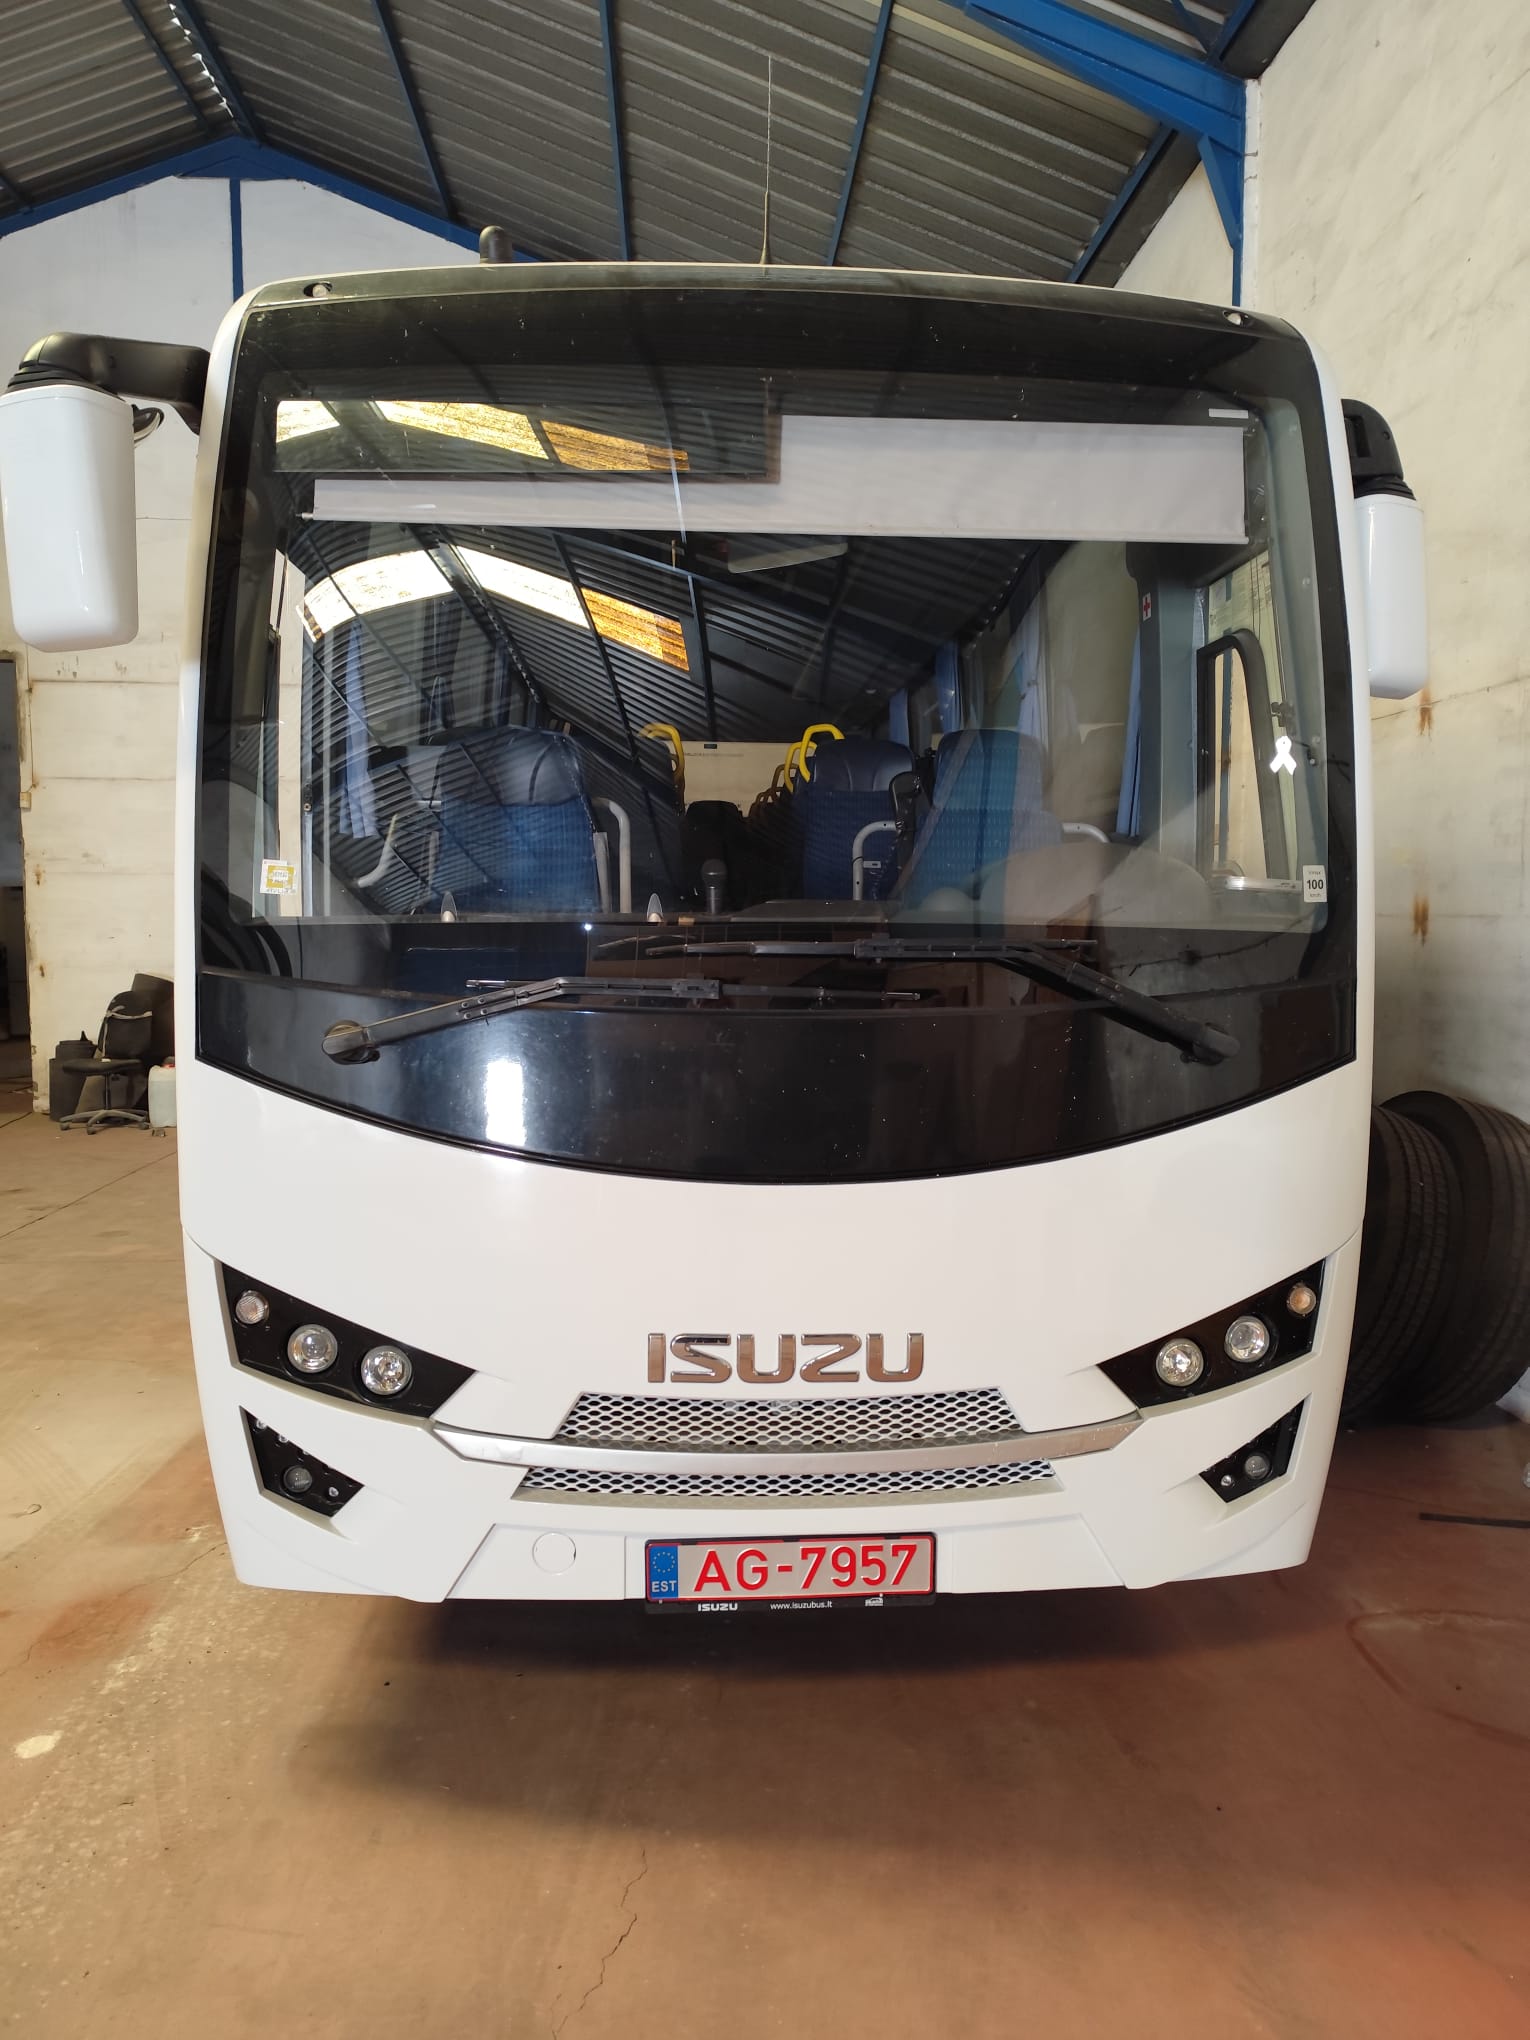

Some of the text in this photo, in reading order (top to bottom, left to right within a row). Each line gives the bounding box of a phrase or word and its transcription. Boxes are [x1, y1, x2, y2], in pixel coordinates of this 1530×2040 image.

[1306, 879, 1324, 890] 100
[647, 1333, 924, 1383] ISUZU
[693, 1543, 918, 1592] AG-7957
[651, 1580, 677, 1593] EST
[697, 1602, 738, 1612] ISUZU
